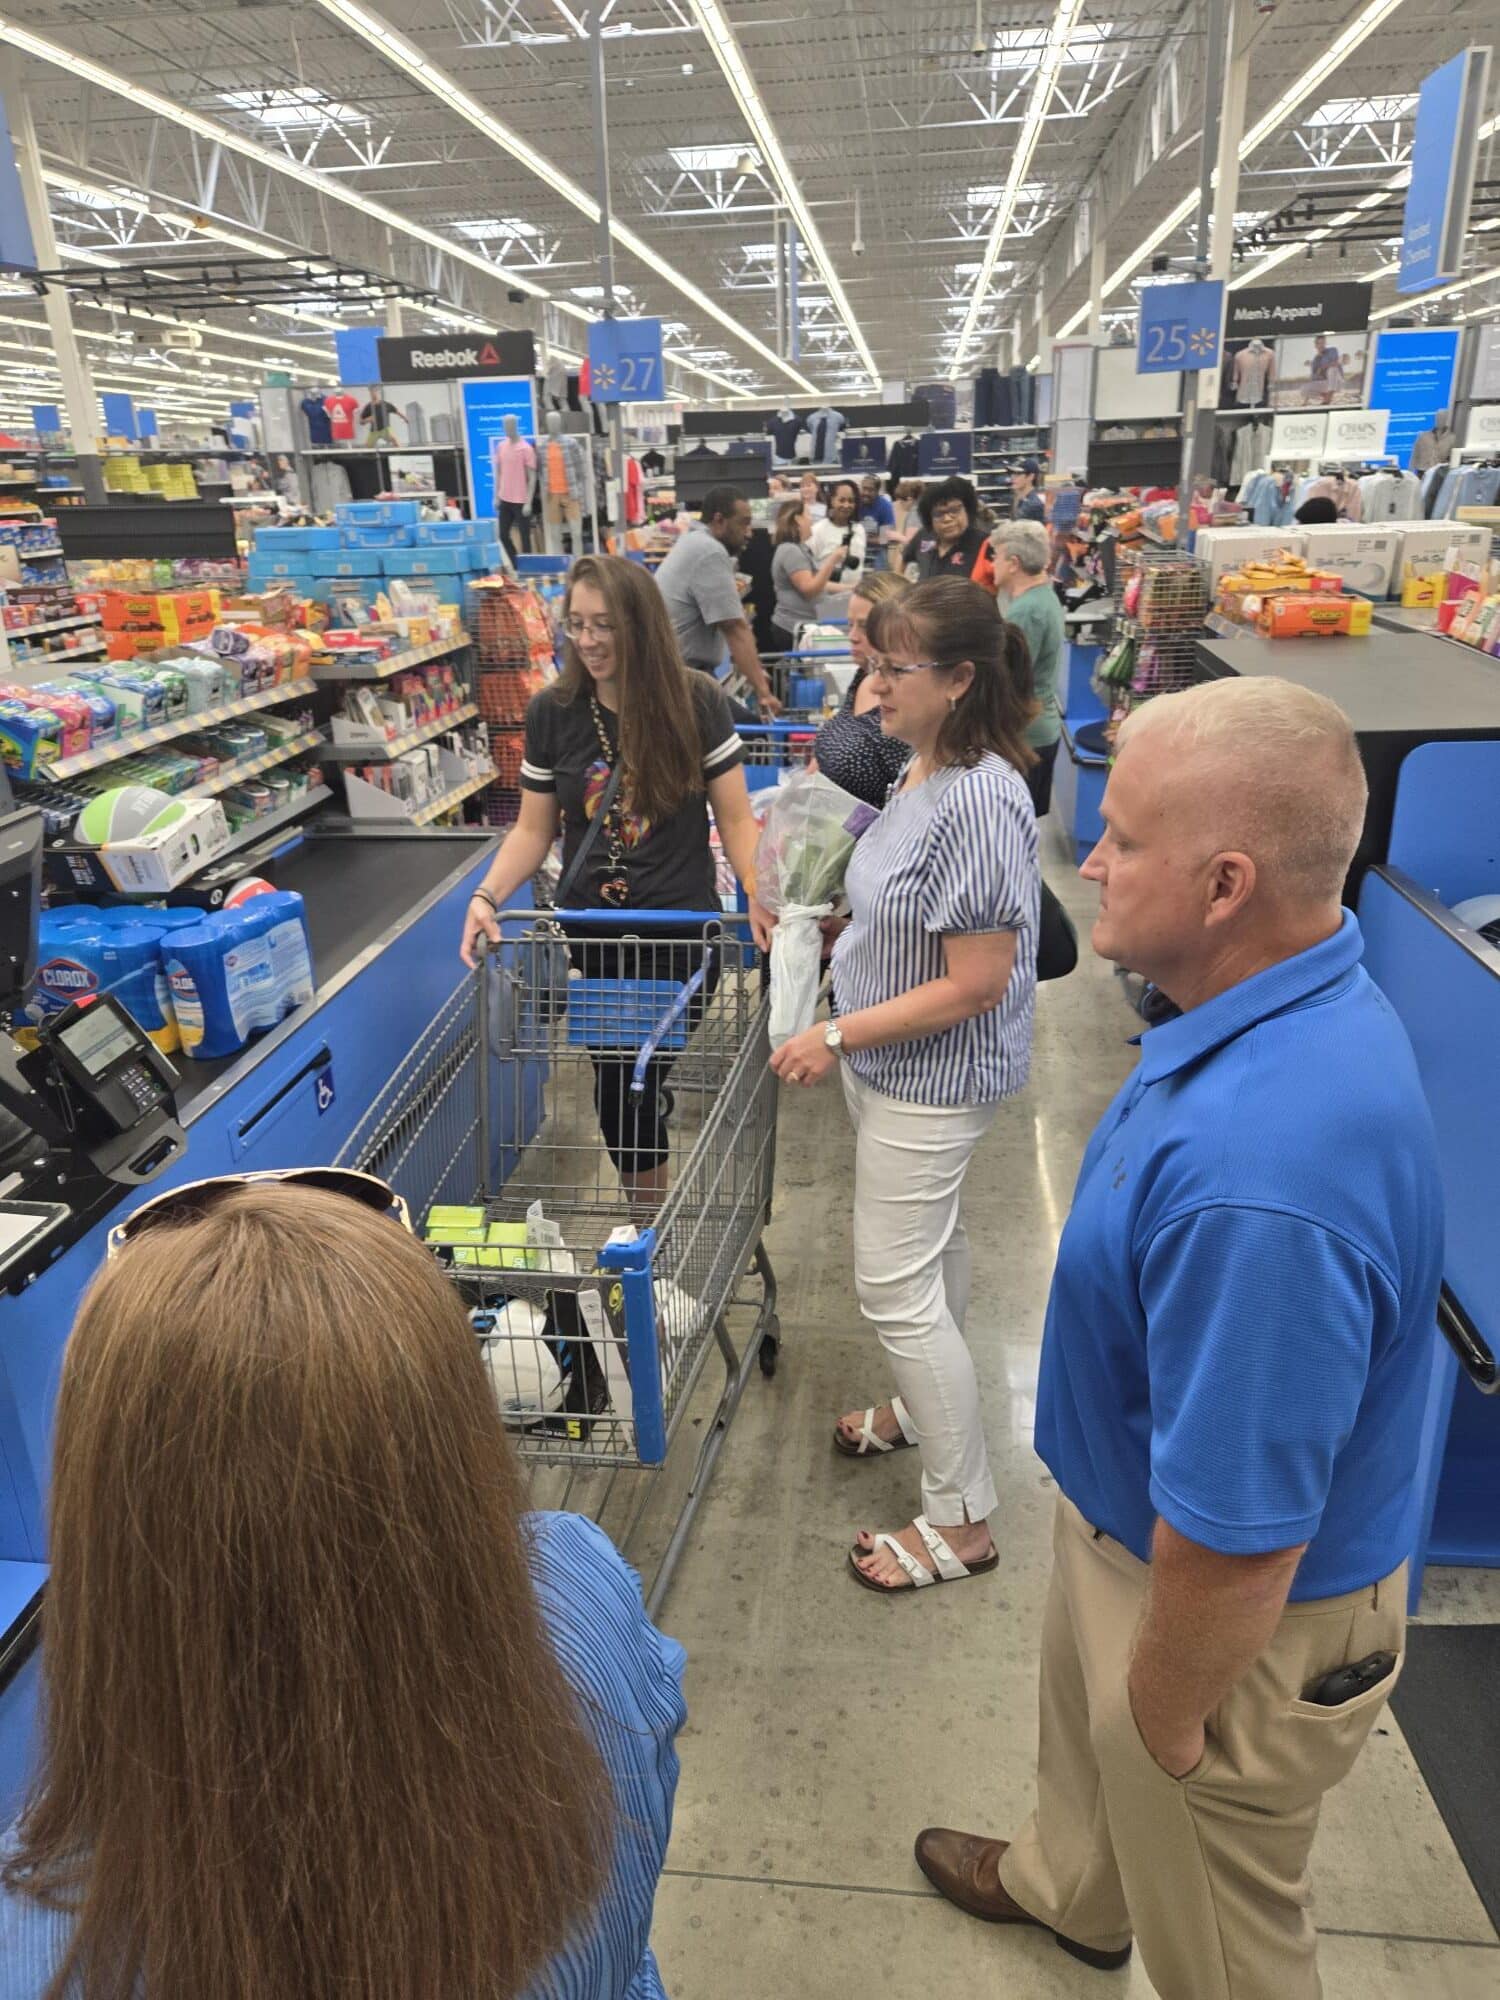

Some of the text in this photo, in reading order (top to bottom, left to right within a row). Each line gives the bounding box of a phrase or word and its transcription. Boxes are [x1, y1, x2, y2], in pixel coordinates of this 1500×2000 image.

[1233, 303, 1323, 322] Men's Apparel
[1146, 325, 1188, 363] 25
[410, 349, 479, 368] Reebok
[620, 357, 656, 392] 27
[43, 969, 91, 988] CLOROX
[567, 1420, 581, 1438] 5
